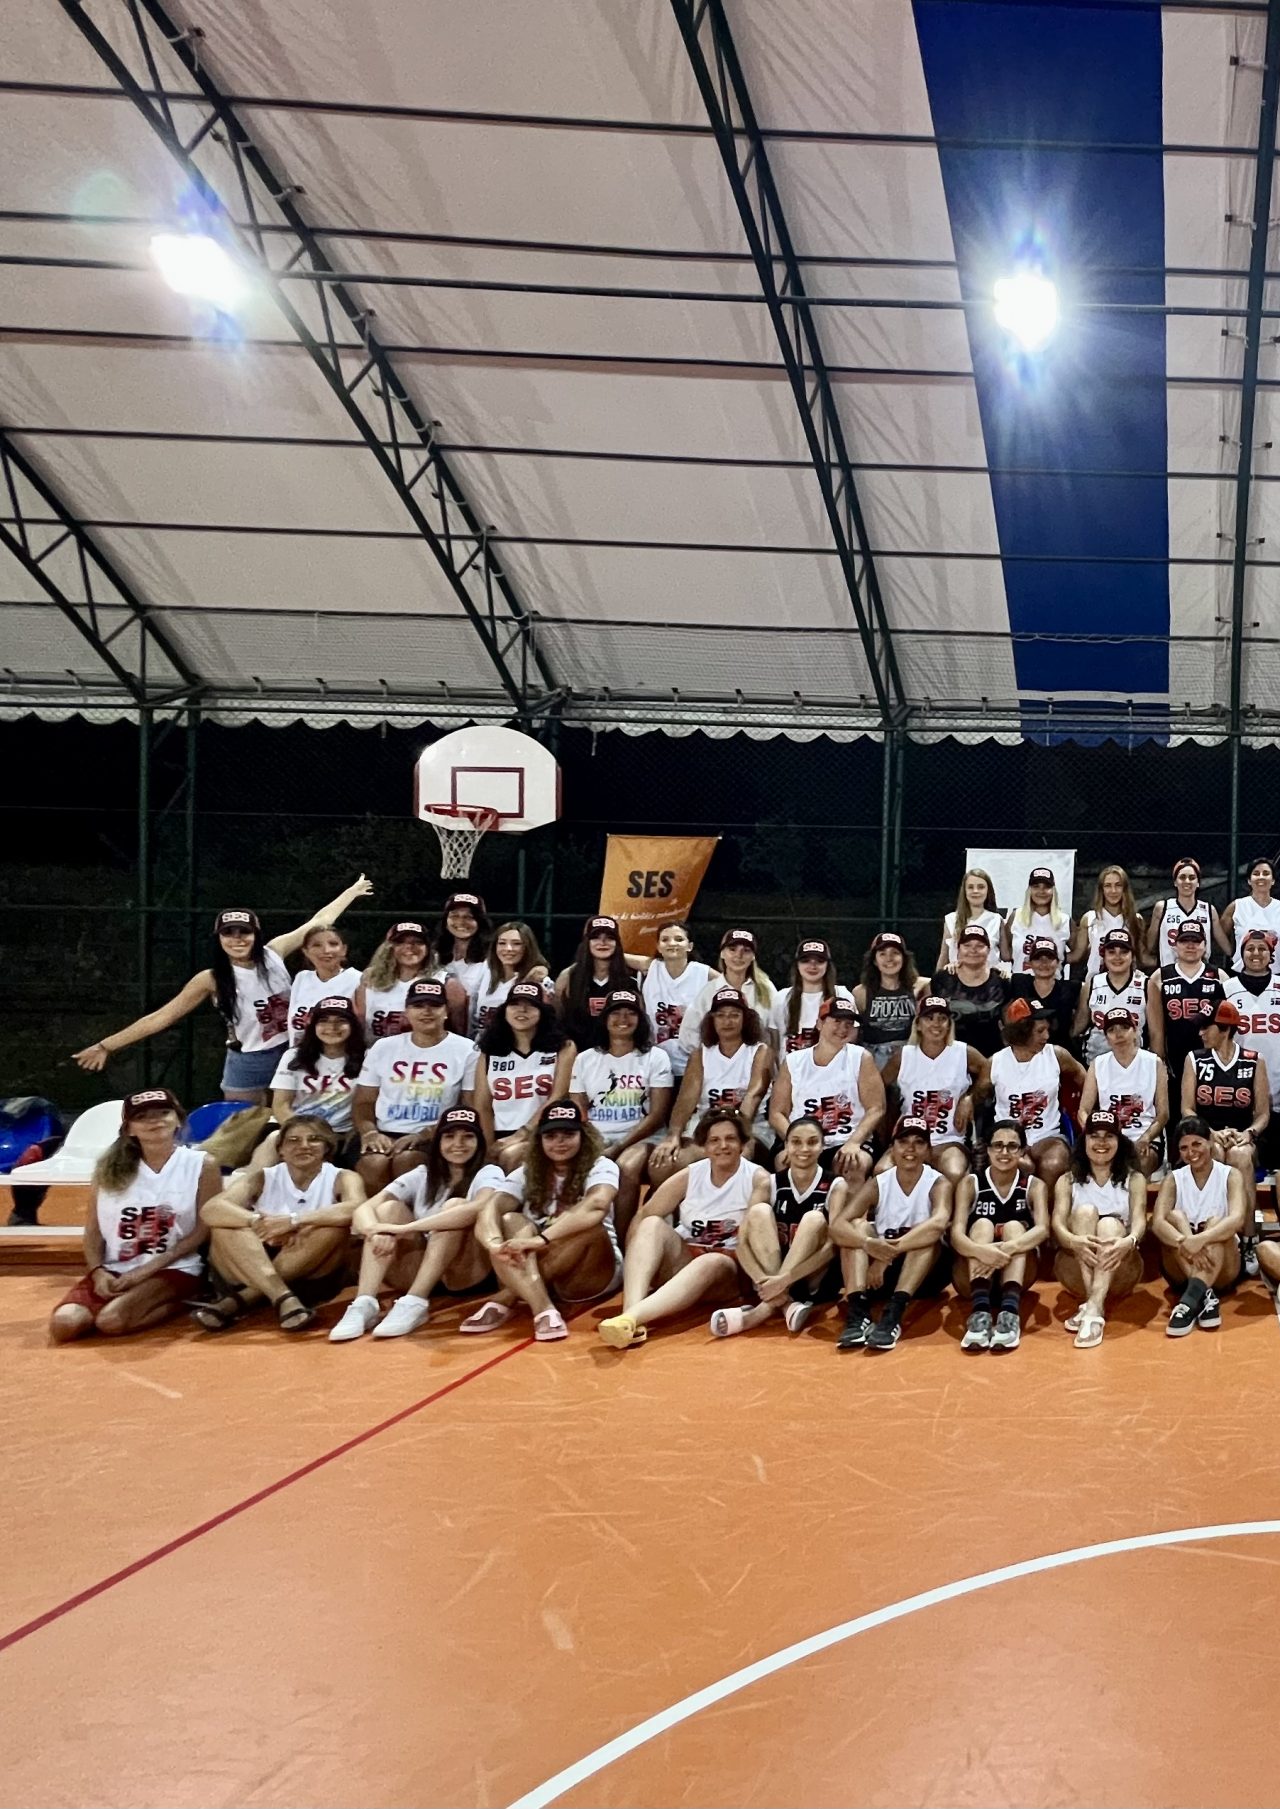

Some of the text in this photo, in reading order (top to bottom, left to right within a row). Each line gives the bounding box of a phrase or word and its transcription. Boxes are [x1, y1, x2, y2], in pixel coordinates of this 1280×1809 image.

[627, 870, 675, 898] SES
[415, 983, 442, 995] SES
[321, 998, 348, 1009] SES
[390, 1061, 448, 1084] SES
[1199, 1063, 1214, 1081] 75
[303, 1074, 351, 1094] SES
[492, 1074, 554, 1101] SES
[620, 1075, 643, 1089] SES
[131, 1090, 168, 1105] SES
[406, 1085, 444, 1101] SPOR
[1197, 1085, 1251, 1108] SES
[447, 1109, 476, 1122] SES
[549, 1107, 576, 1119] SES
[588, 1107, 641, 1120] PORLARI
[1092, 1111, 1115, 1123] SES
[976, 1201, 997, 1216] 296
